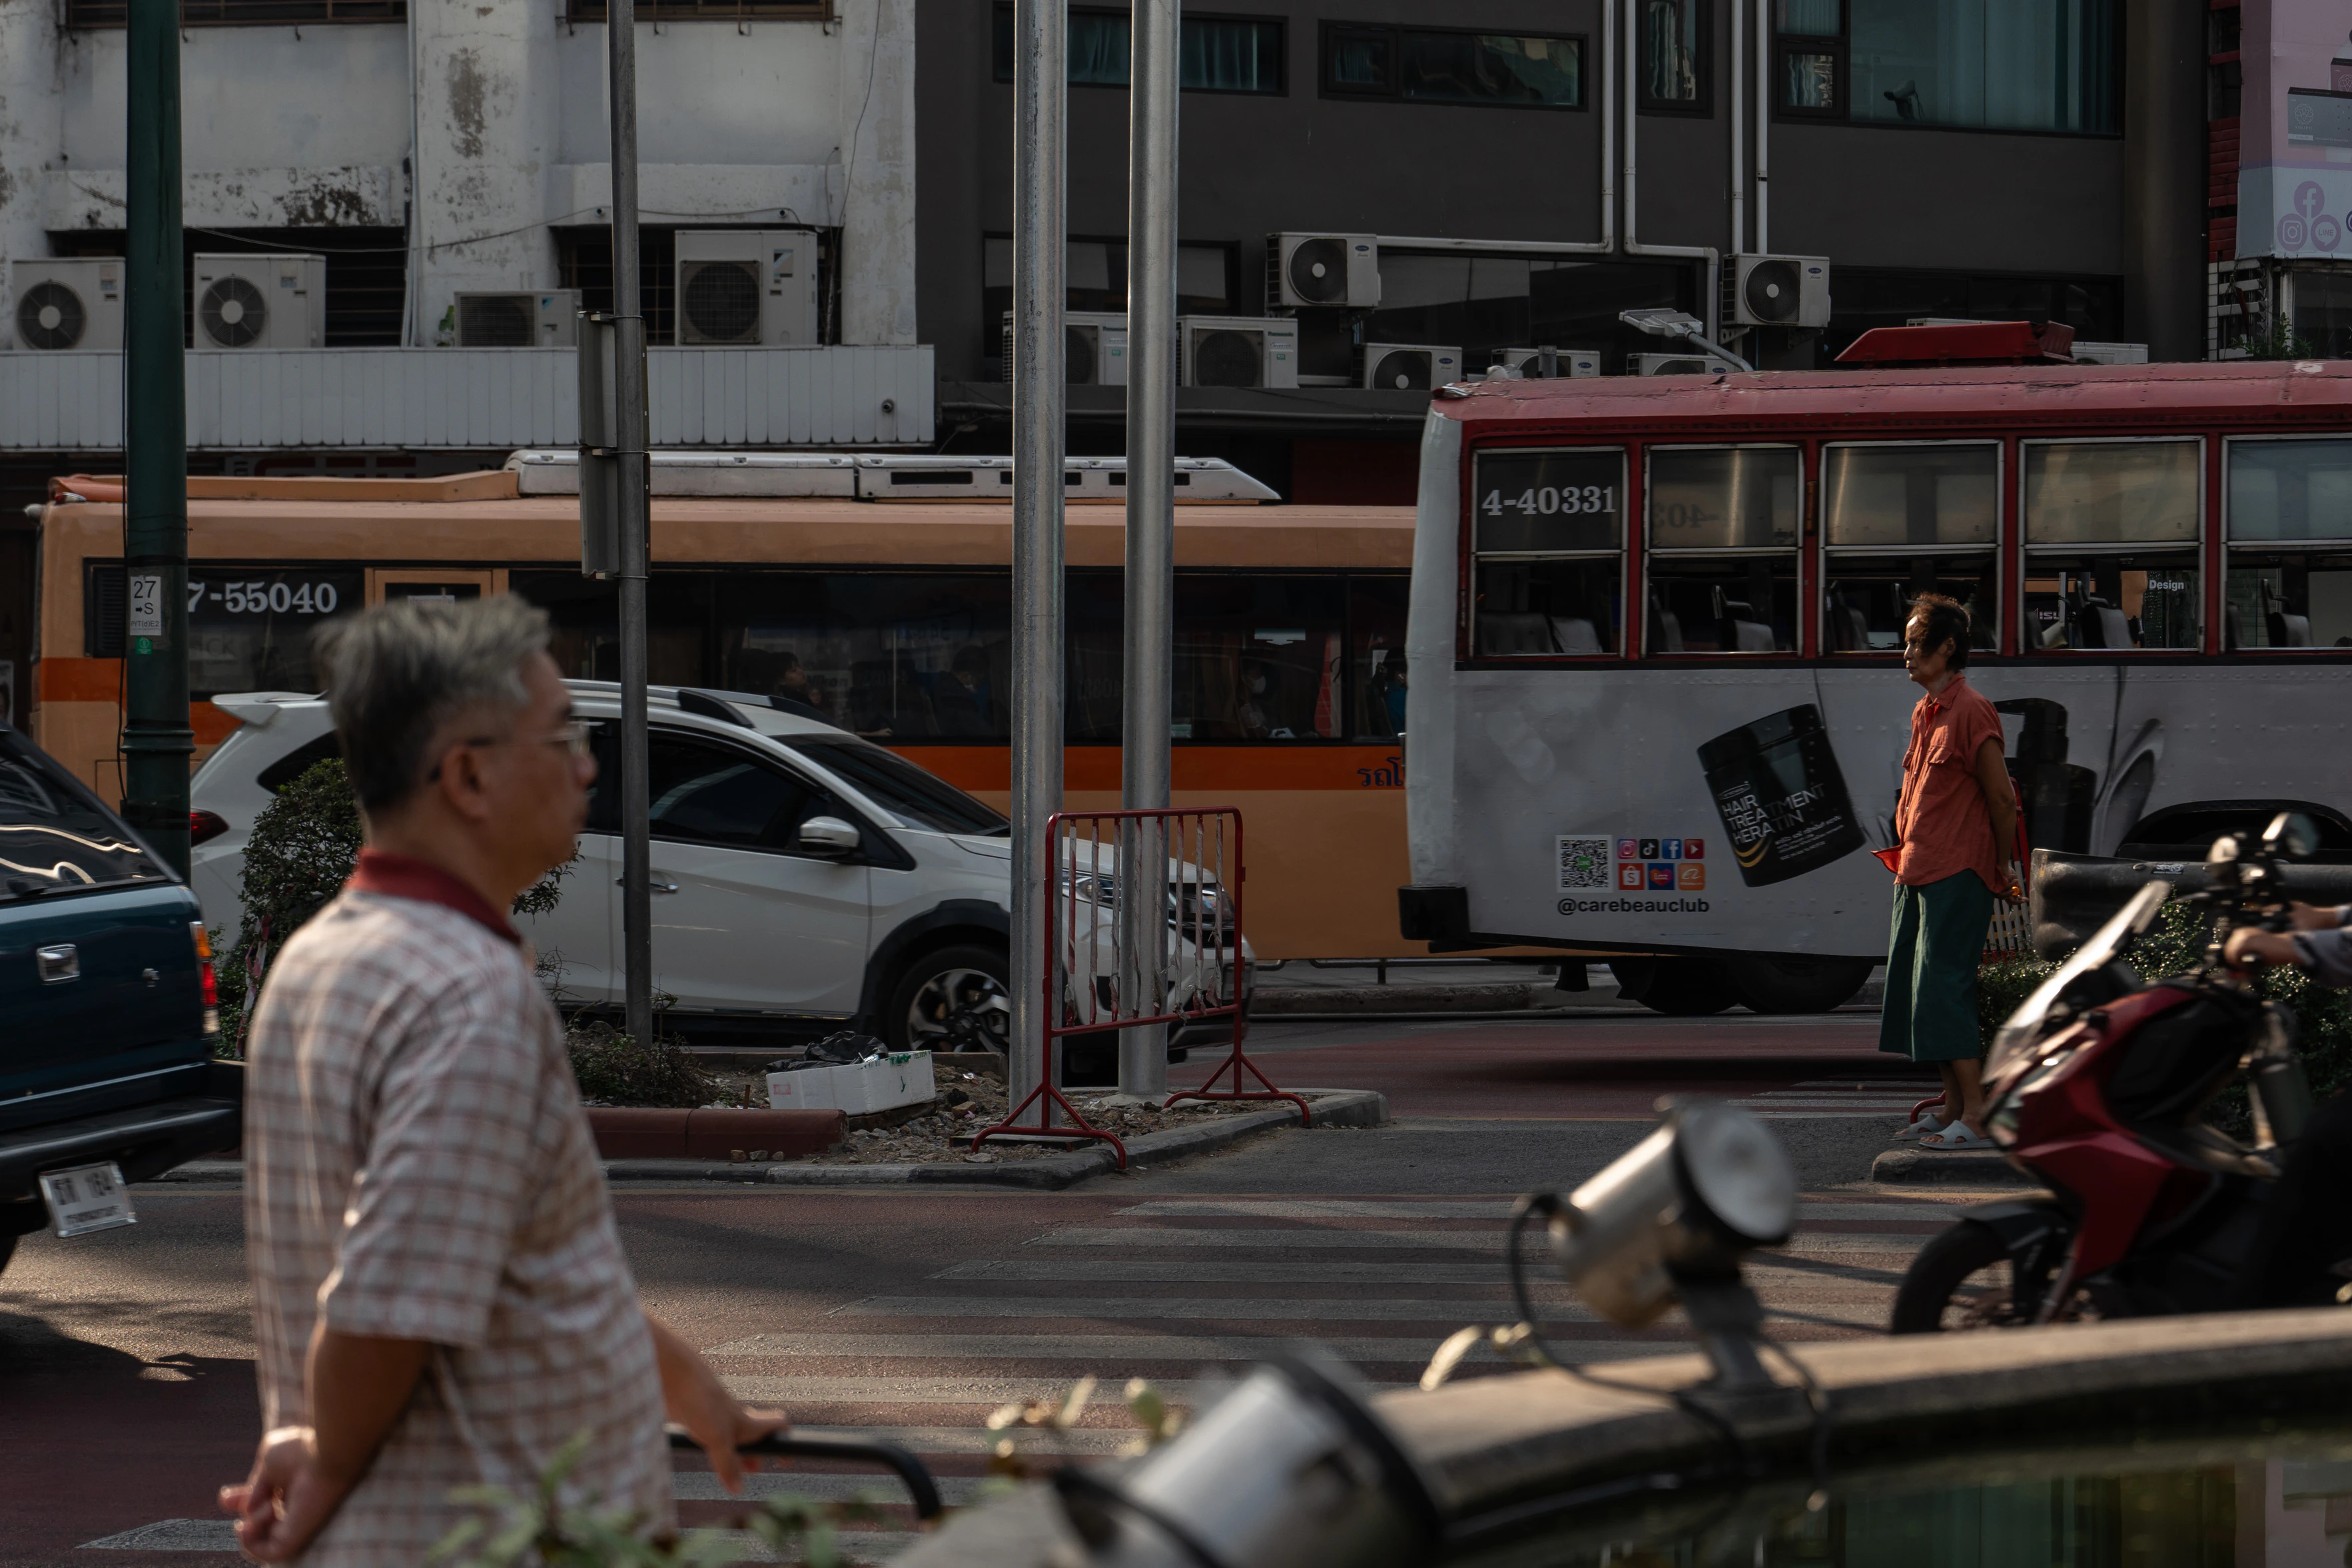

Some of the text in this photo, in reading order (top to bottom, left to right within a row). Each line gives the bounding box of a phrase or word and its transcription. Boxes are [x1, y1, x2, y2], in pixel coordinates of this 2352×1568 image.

[1481, 486, 1617, 516] 4-40331
[134, 580, 157, 599] 27
[2149, 580, 2185, 591] Design
[187, 581, 337, 614] 7-55040
[144, 602, 154, 615] S
[1721, 794, 1759, 818] HAIR
[1727, 783, 1826, 831] TREATMENT
[1557, 898, 1710, 916] @carebeauclub
